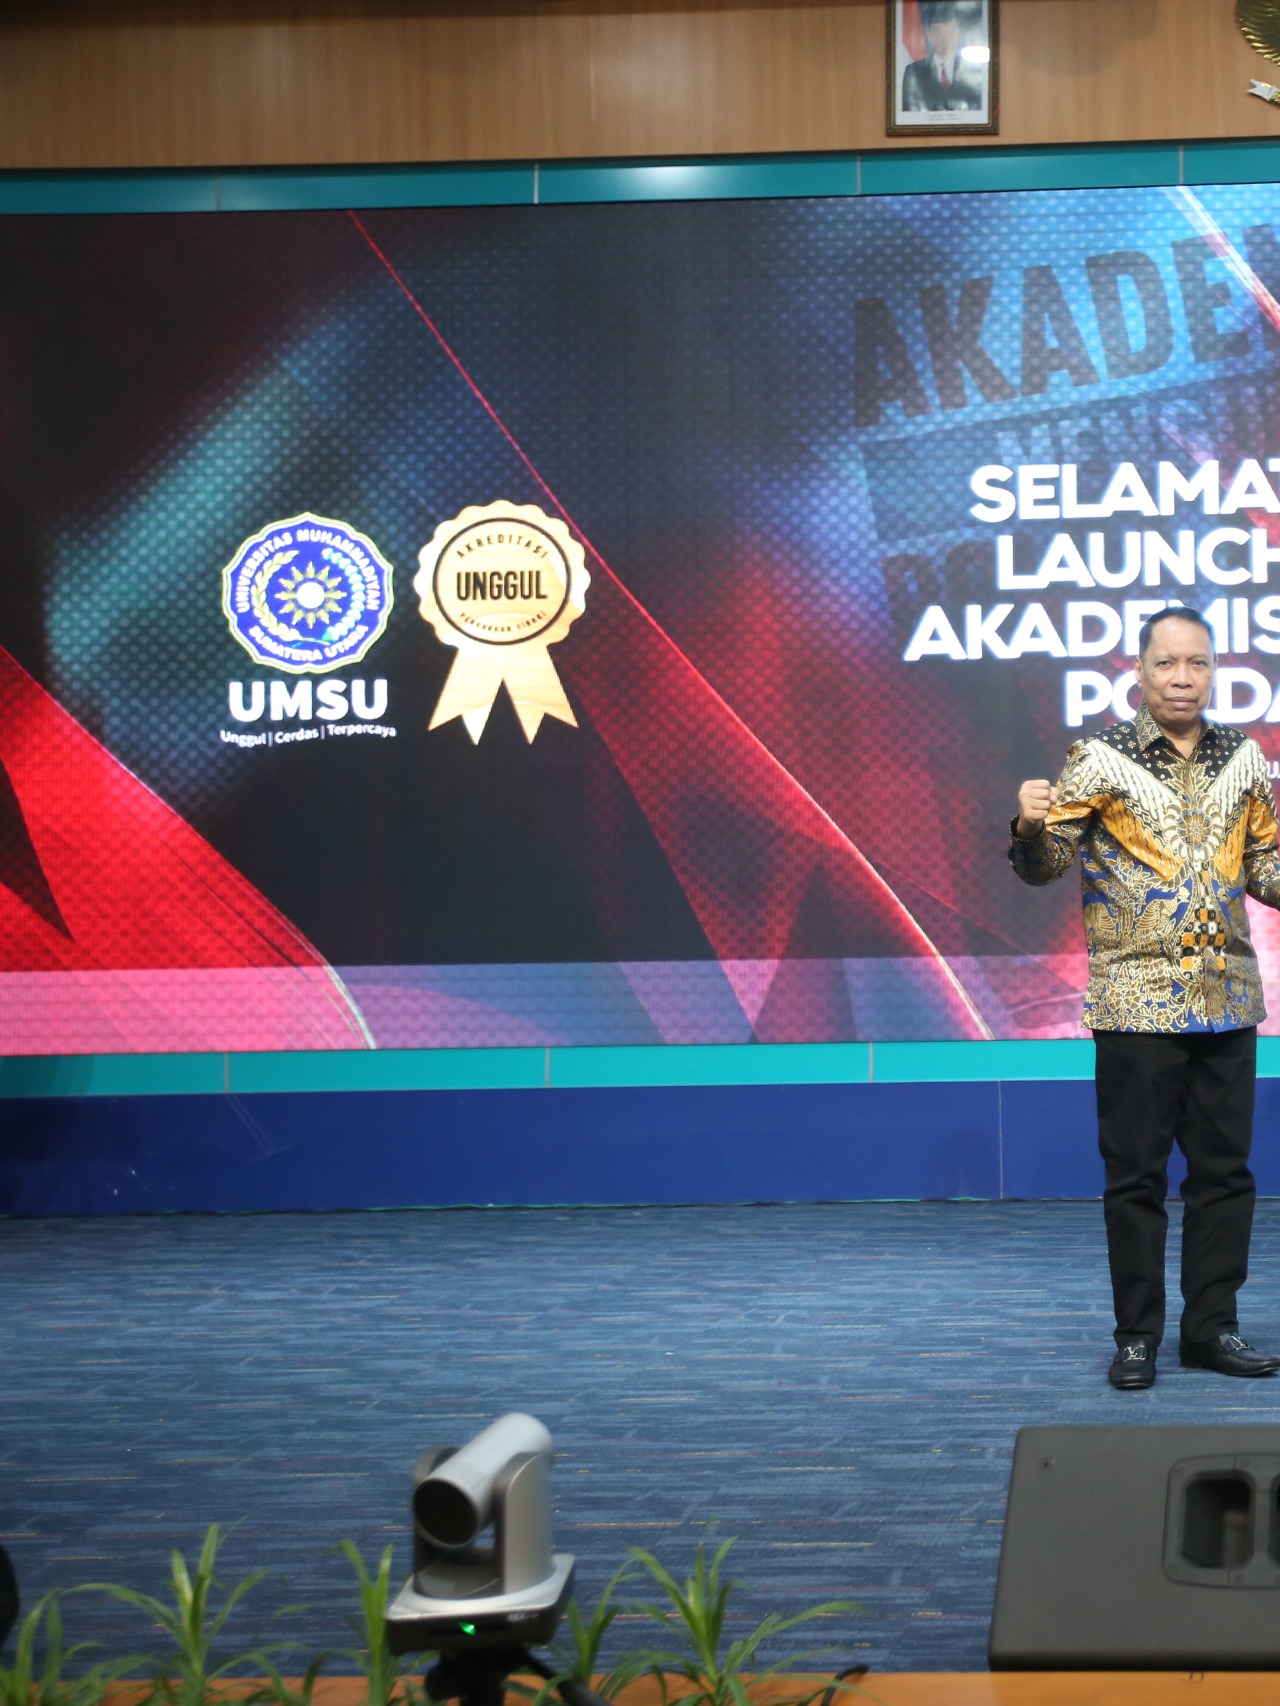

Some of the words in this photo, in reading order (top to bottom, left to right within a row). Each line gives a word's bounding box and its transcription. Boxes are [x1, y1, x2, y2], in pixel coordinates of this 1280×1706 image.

[456, 534, 549, 558] AKREDITASI
[235, 532, 293, 614] UNIVERSITAS
[296, 529, 381, 611] MUHAMMADIYAH
[456, 570, 548, 602] UNGGUL
[249, 625, 323, 662] SUMATERA
[324, 624, 369, 658] UTARA
[228, 678, 388, 722] UMSU
[220, 730, 267, 748] Unggul
[274, 728, 319, 744] Cerdas
[326, 724, 397, 738] Terpercaya
